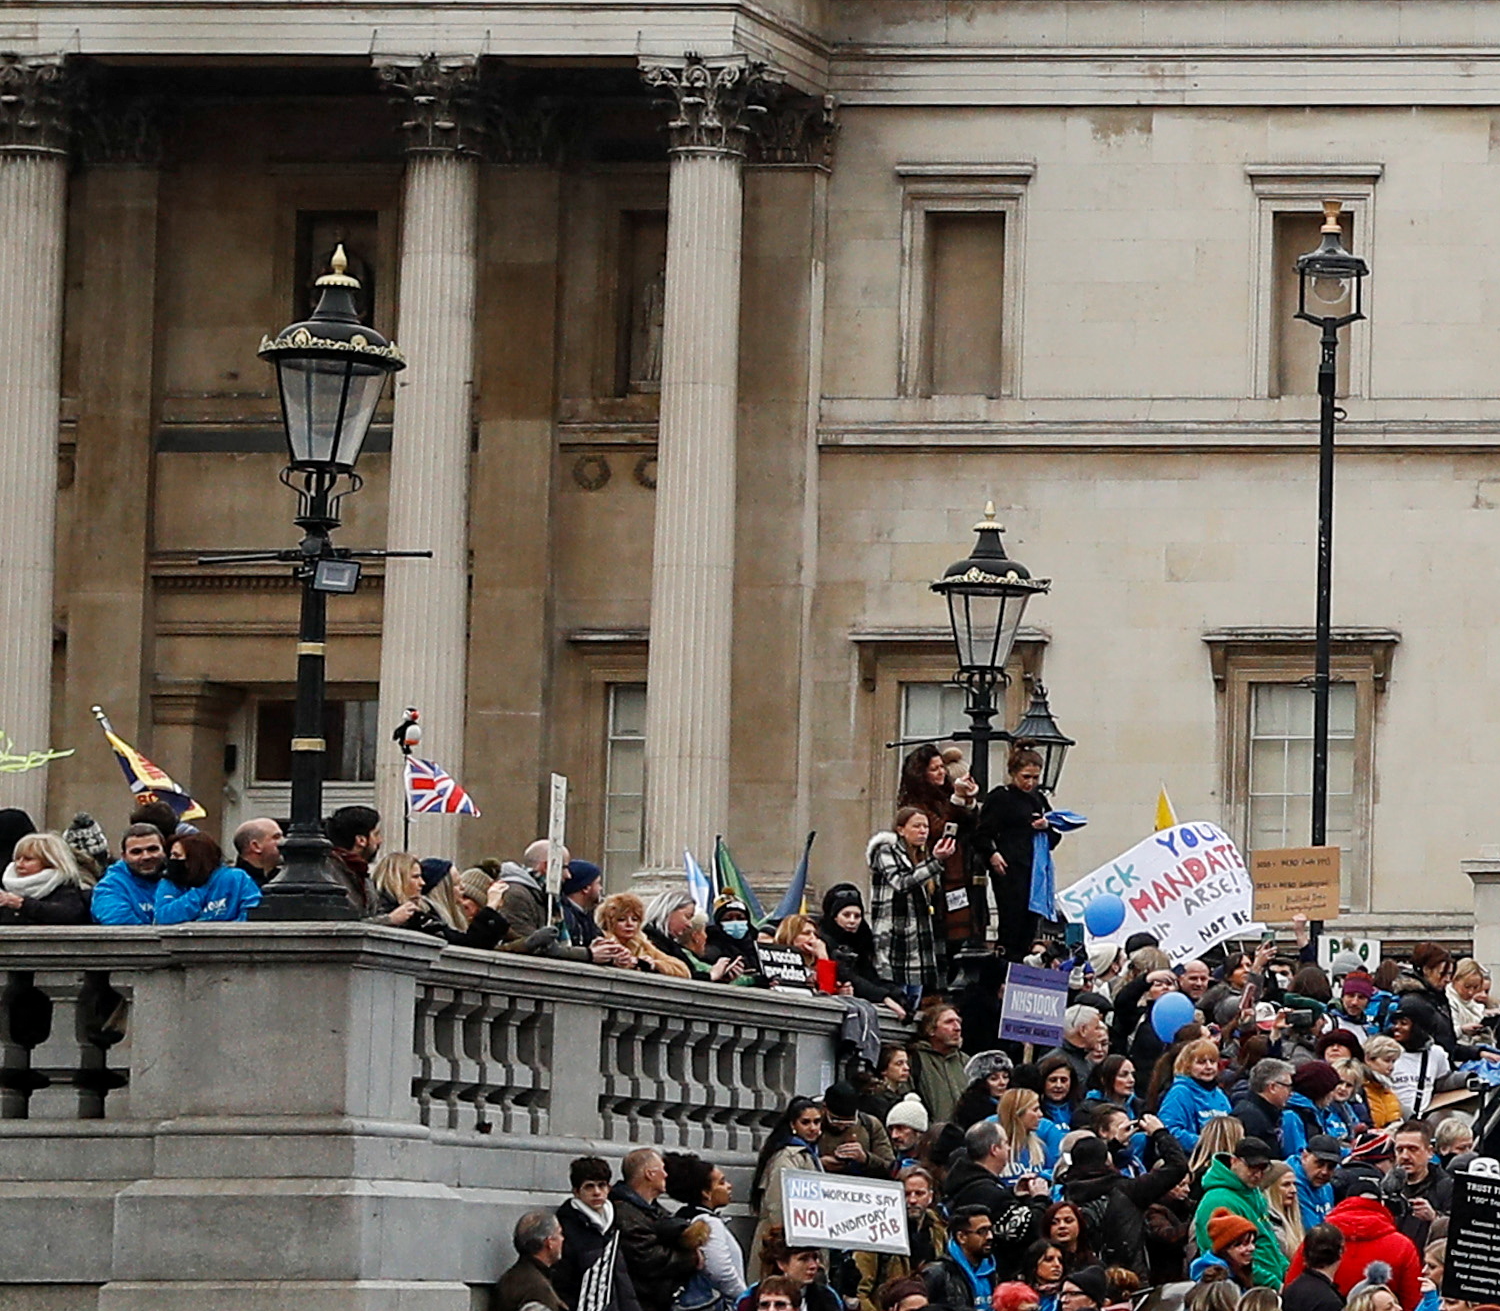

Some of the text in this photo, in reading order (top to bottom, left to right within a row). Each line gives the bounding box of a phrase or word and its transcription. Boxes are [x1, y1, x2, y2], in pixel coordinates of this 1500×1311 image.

[1128, 844, 1245, 922] MANDATE
[1183, 872, 1242, 916] ARSE!
[1198, 909, 1250, 942] NOT BE
[789, 1179, 899, 1208] NHS WORKERS SAY
[1466, 1182, 1492, 1194] TRUST
[793, 1208, 824, 1229] NO!
[827, 1207, 888, 1238] MANDATORY
[868, 1218, 901, 1244] JAB
